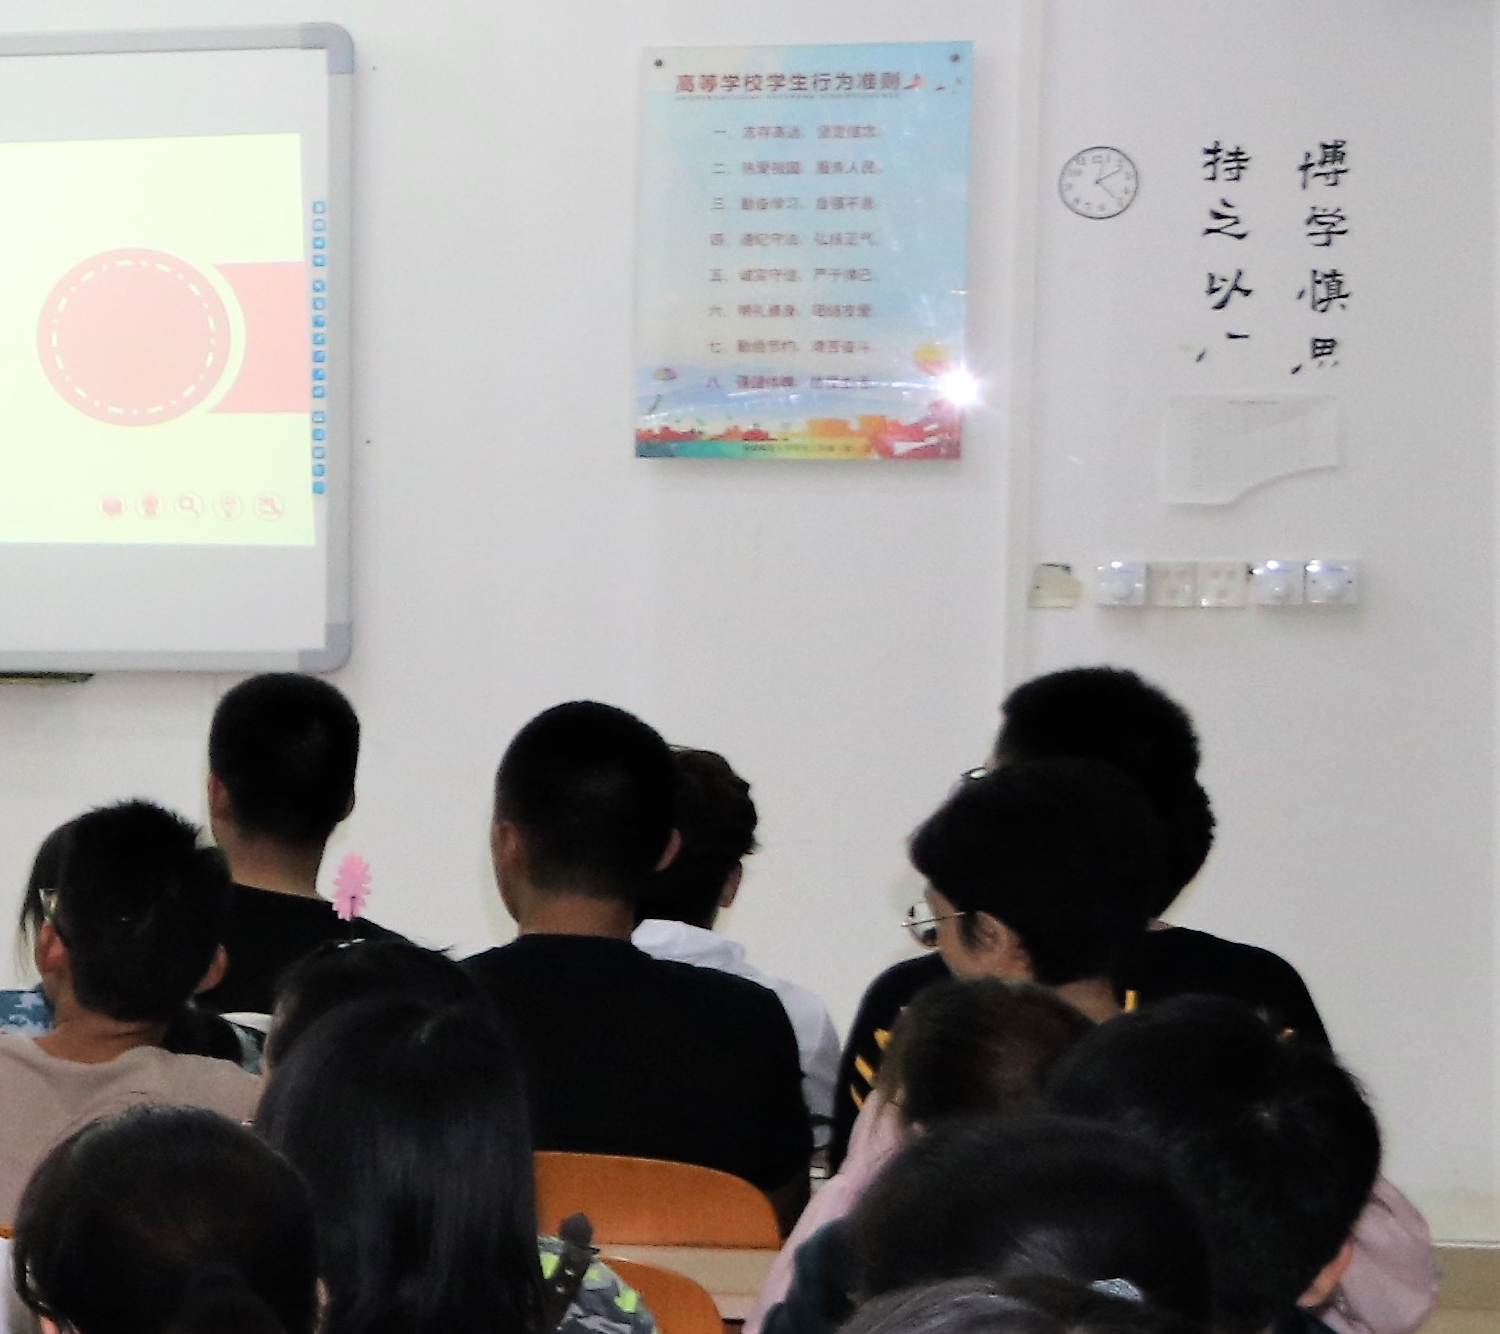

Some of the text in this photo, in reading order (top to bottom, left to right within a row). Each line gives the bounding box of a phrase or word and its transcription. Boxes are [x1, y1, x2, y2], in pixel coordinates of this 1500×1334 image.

[675, 72, 901, 93] 高等学校学生行为准则
[1195, 139, 1253, 364] 持之以
